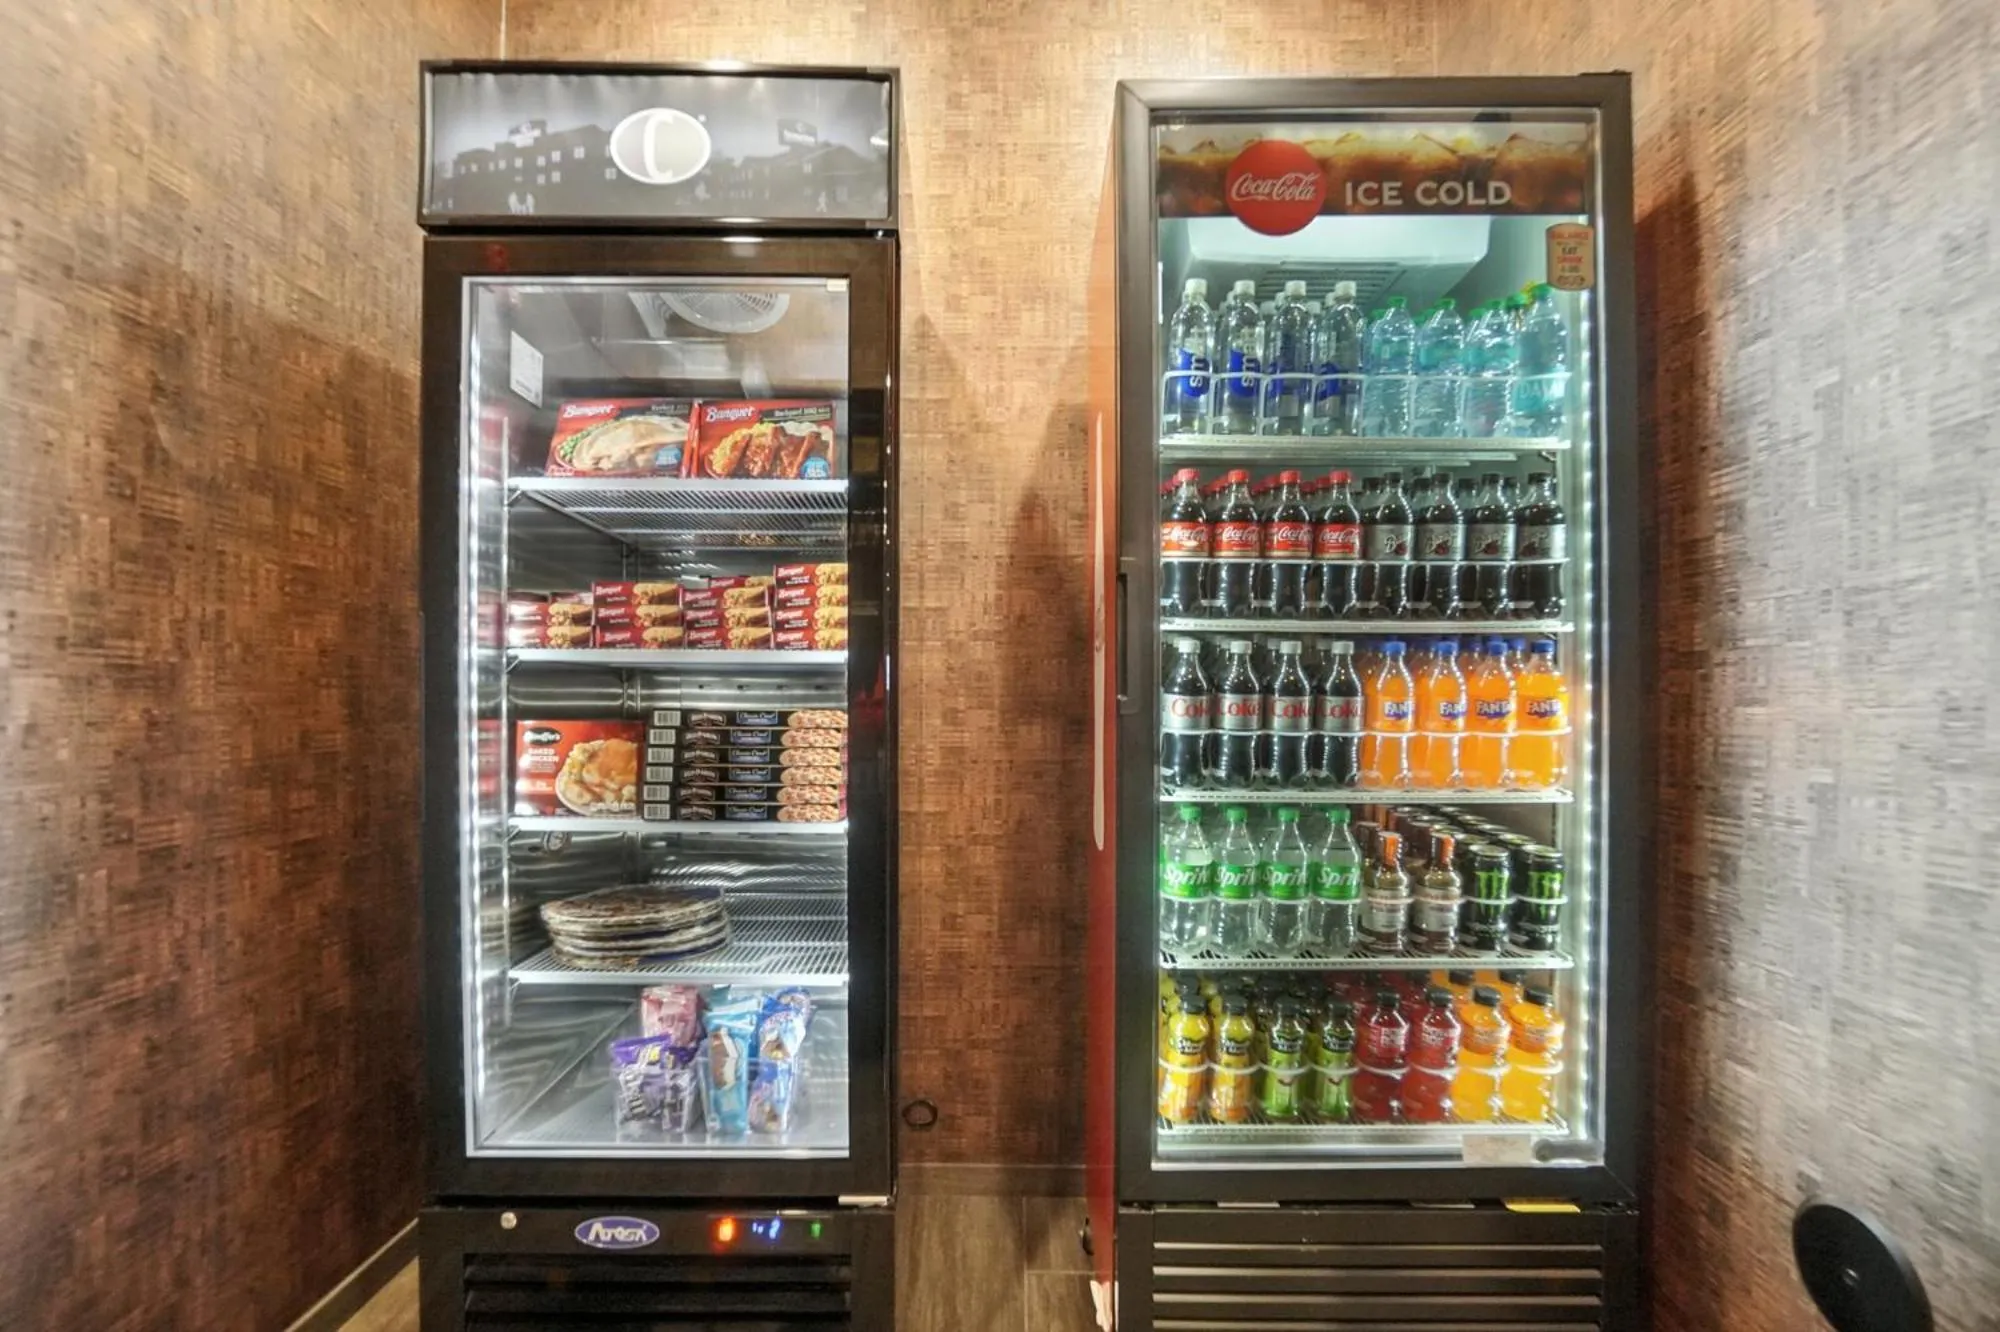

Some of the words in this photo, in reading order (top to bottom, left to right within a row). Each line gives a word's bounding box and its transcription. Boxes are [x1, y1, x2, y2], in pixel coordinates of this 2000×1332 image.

[1231, 172, 1319, 201] Coca-Cola
[1345, 181, 1403, 206] ICE
[1415, 181, 1512, 206] COLD
